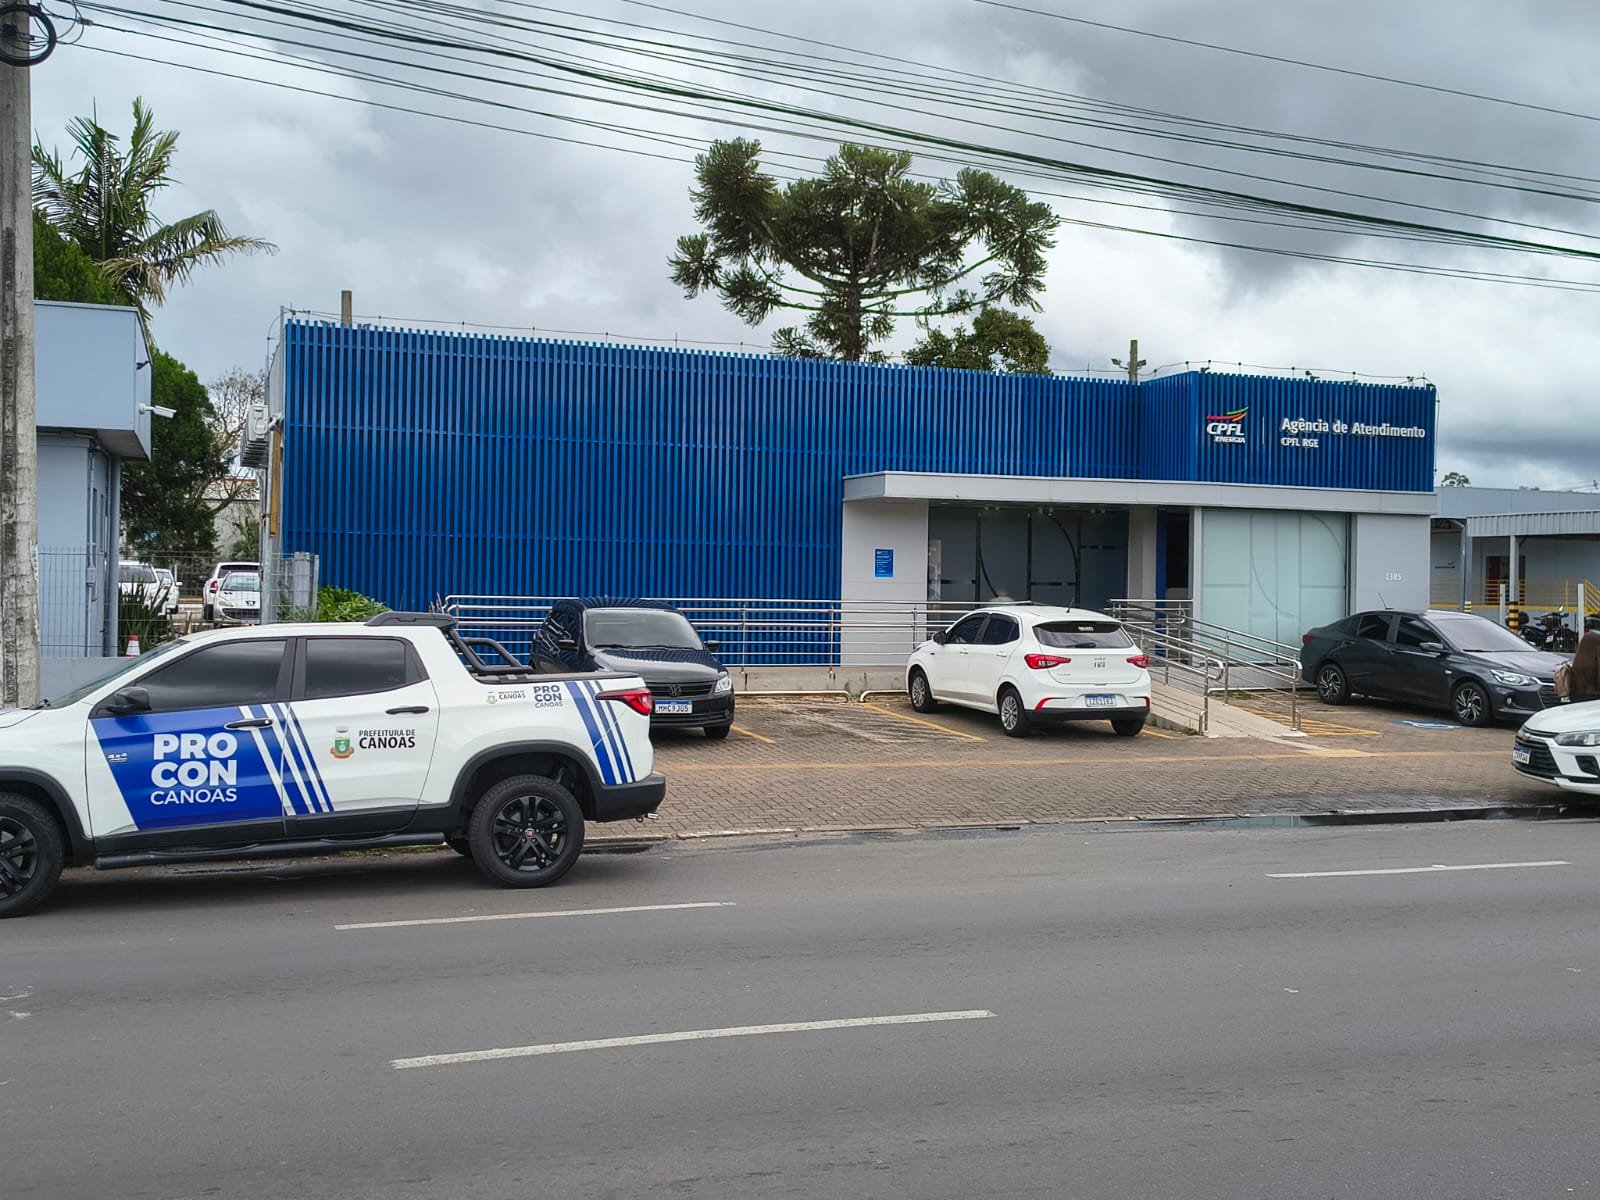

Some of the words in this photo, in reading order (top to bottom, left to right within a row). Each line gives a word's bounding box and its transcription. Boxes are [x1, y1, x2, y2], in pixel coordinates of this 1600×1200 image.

[1206, 422, 1245, 436] CPFL
[1281, 417, 1329, 434] Agência
[1332, 419, 1349, 433] de
[1351, 422, 1426, 438] Atendimento
[1280, 437, 1301, 447] CPFL
[1302, 438, 1320, 448] RGE
[534, 685, 560, 694] PRO
[534, 693, 562, 702] CON
[534, 701, 563, 709] CANOAS
[359, 729, 404, 737] PREFEITURA
[153, 732, 238, 760] PRO
[359, 736, 416, 749] CANOAS
[151, 759, 238, 788] CON
[150, 787, 238, 805] CANOAS
